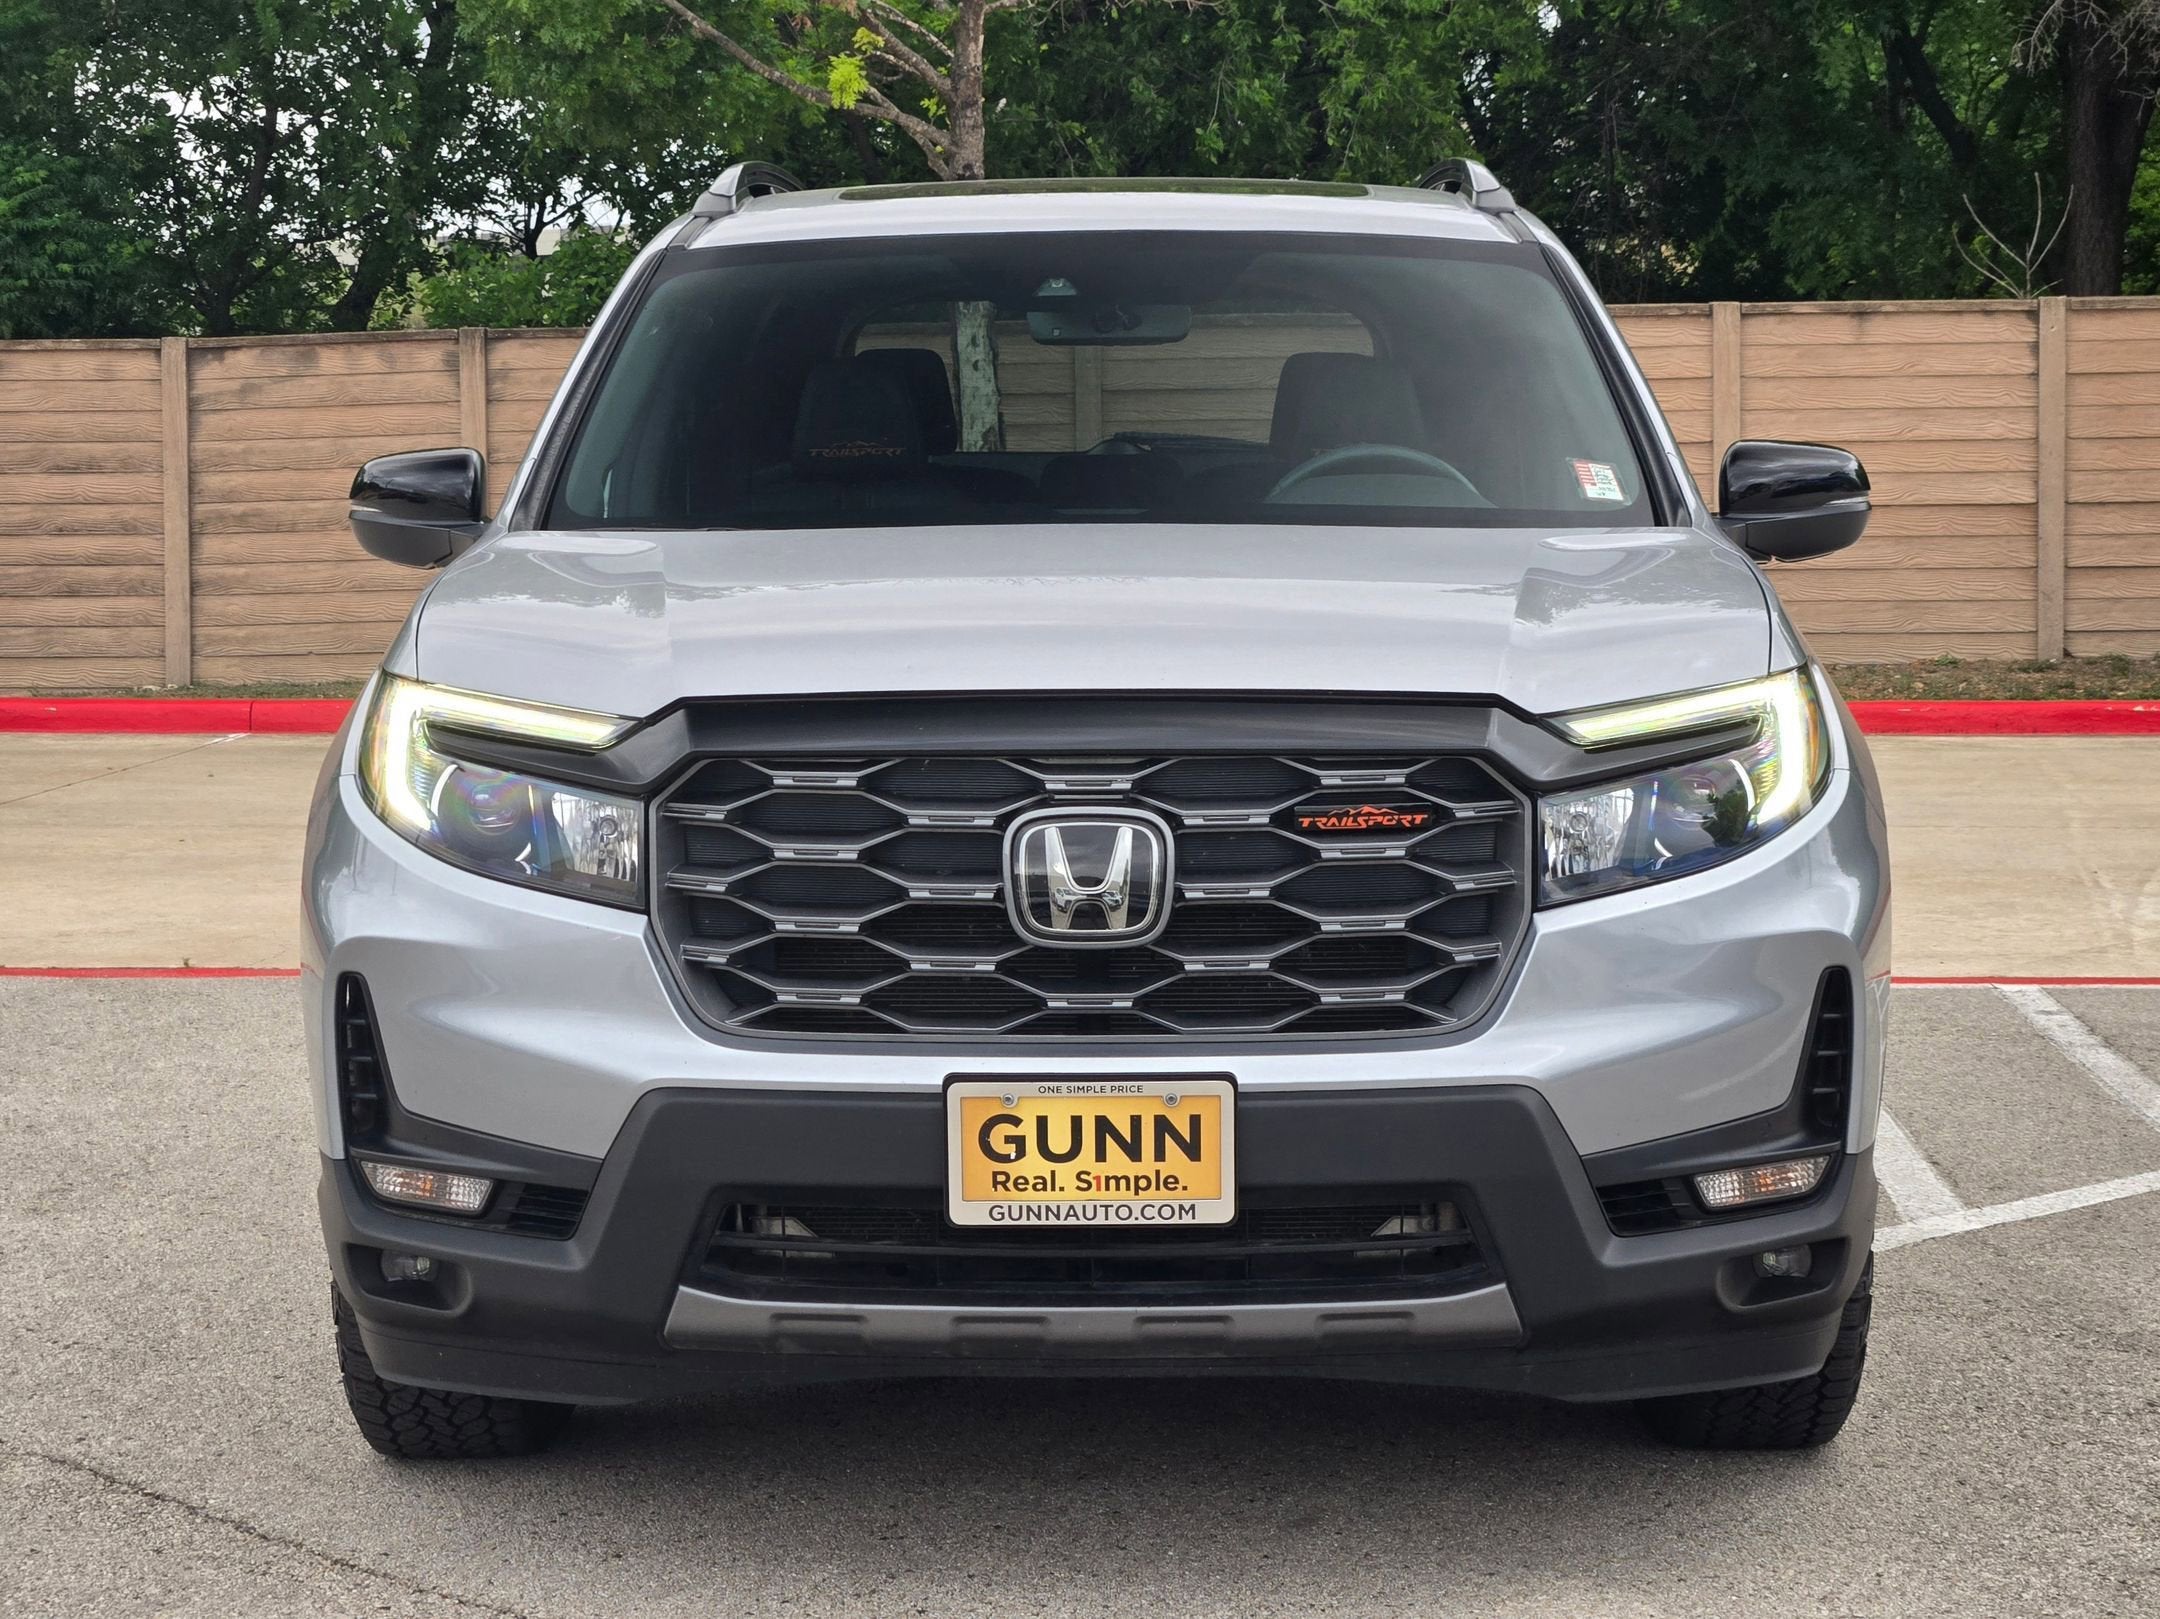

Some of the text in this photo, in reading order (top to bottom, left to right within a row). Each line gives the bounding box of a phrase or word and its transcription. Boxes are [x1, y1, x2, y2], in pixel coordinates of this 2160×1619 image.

[1298, 814, 1428, 830] TRAILSPORT
[1038, 1084, 1144, 1094] ONE SIMPLE PRICE
[978, 1113, 1202, 1164] GUNN
[991, 1170, 1065, 1193] Real.
[988, 1203, 1197, 1222] GUNNAUTO.COM
